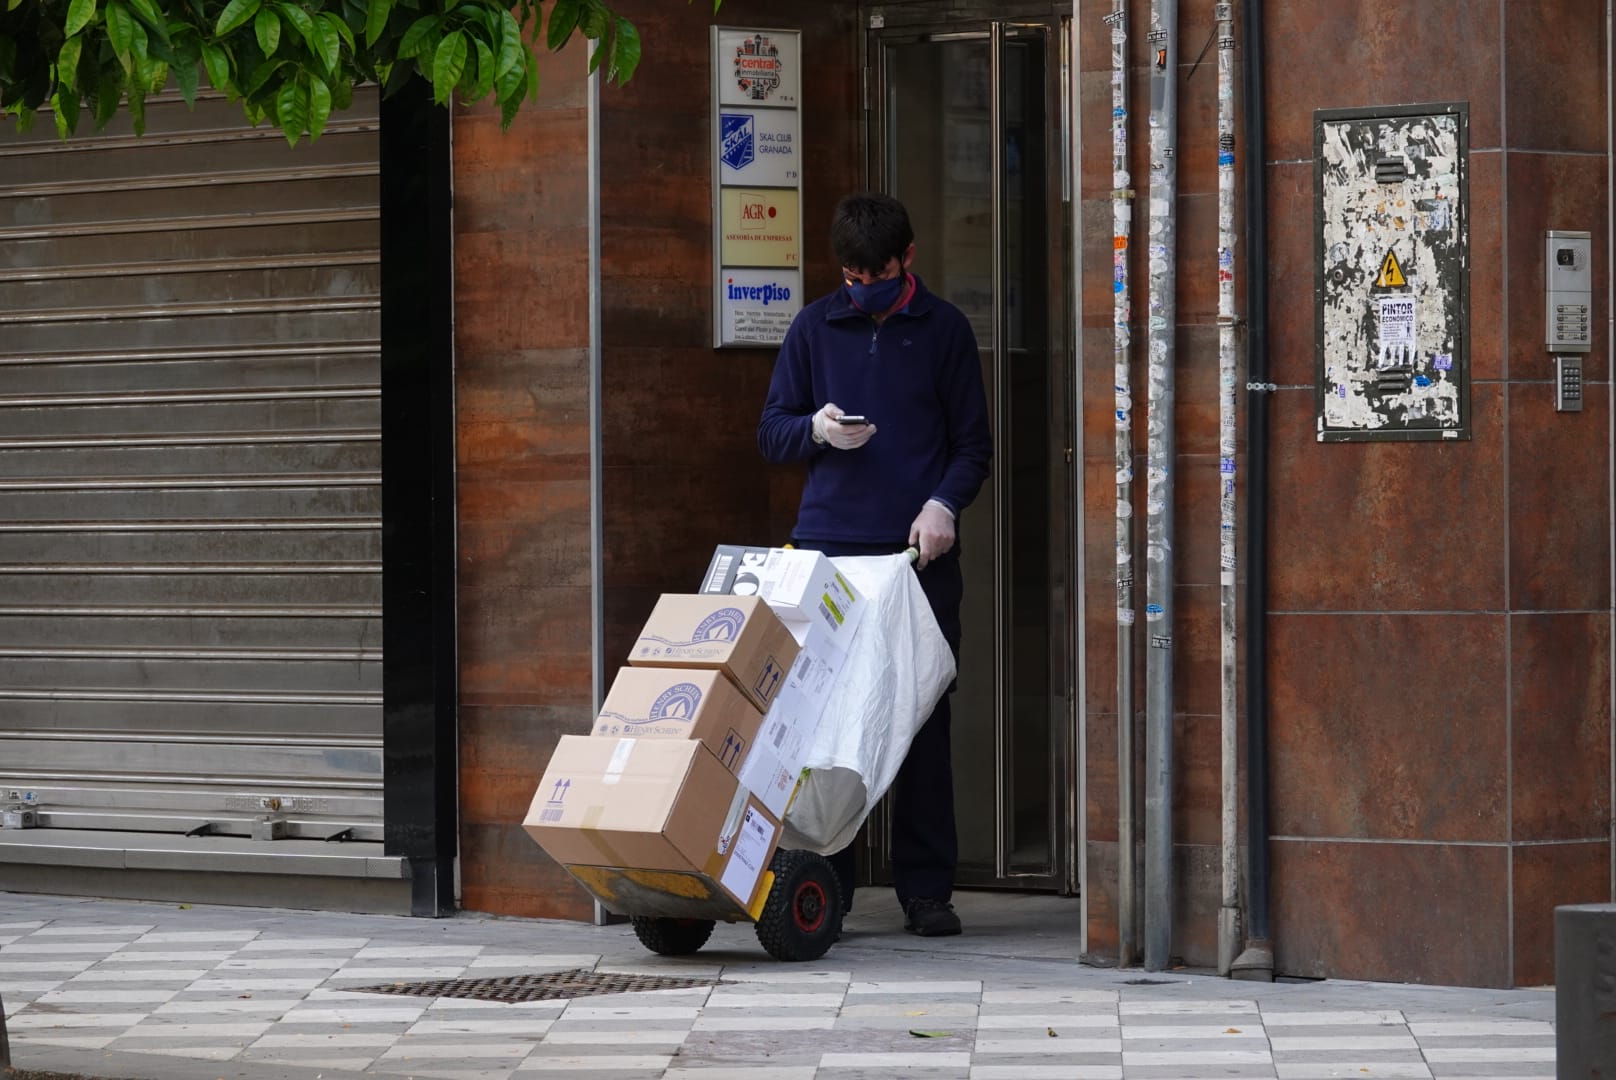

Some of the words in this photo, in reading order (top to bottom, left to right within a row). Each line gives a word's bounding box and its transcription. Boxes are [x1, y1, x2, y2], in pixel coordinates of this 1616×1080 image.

[742, 58, 774, 68] central
[760, 133, 775, 142] SKAL
[776, 133, 792, 142] CLUB
[759, 145, 792, 154] GRANADA
[742, 204, 765, 220] AGR
[728, 278, 791, 305] inverpiso
[1382, 303, 1413, 315] PINTOR
[693, 615, 716, 642] HENRY
[718, 608, 744, 624] SCHEIN
[649, 690, 673, 719] HENRY
[675, 684, 700, 701] SCHEIN
